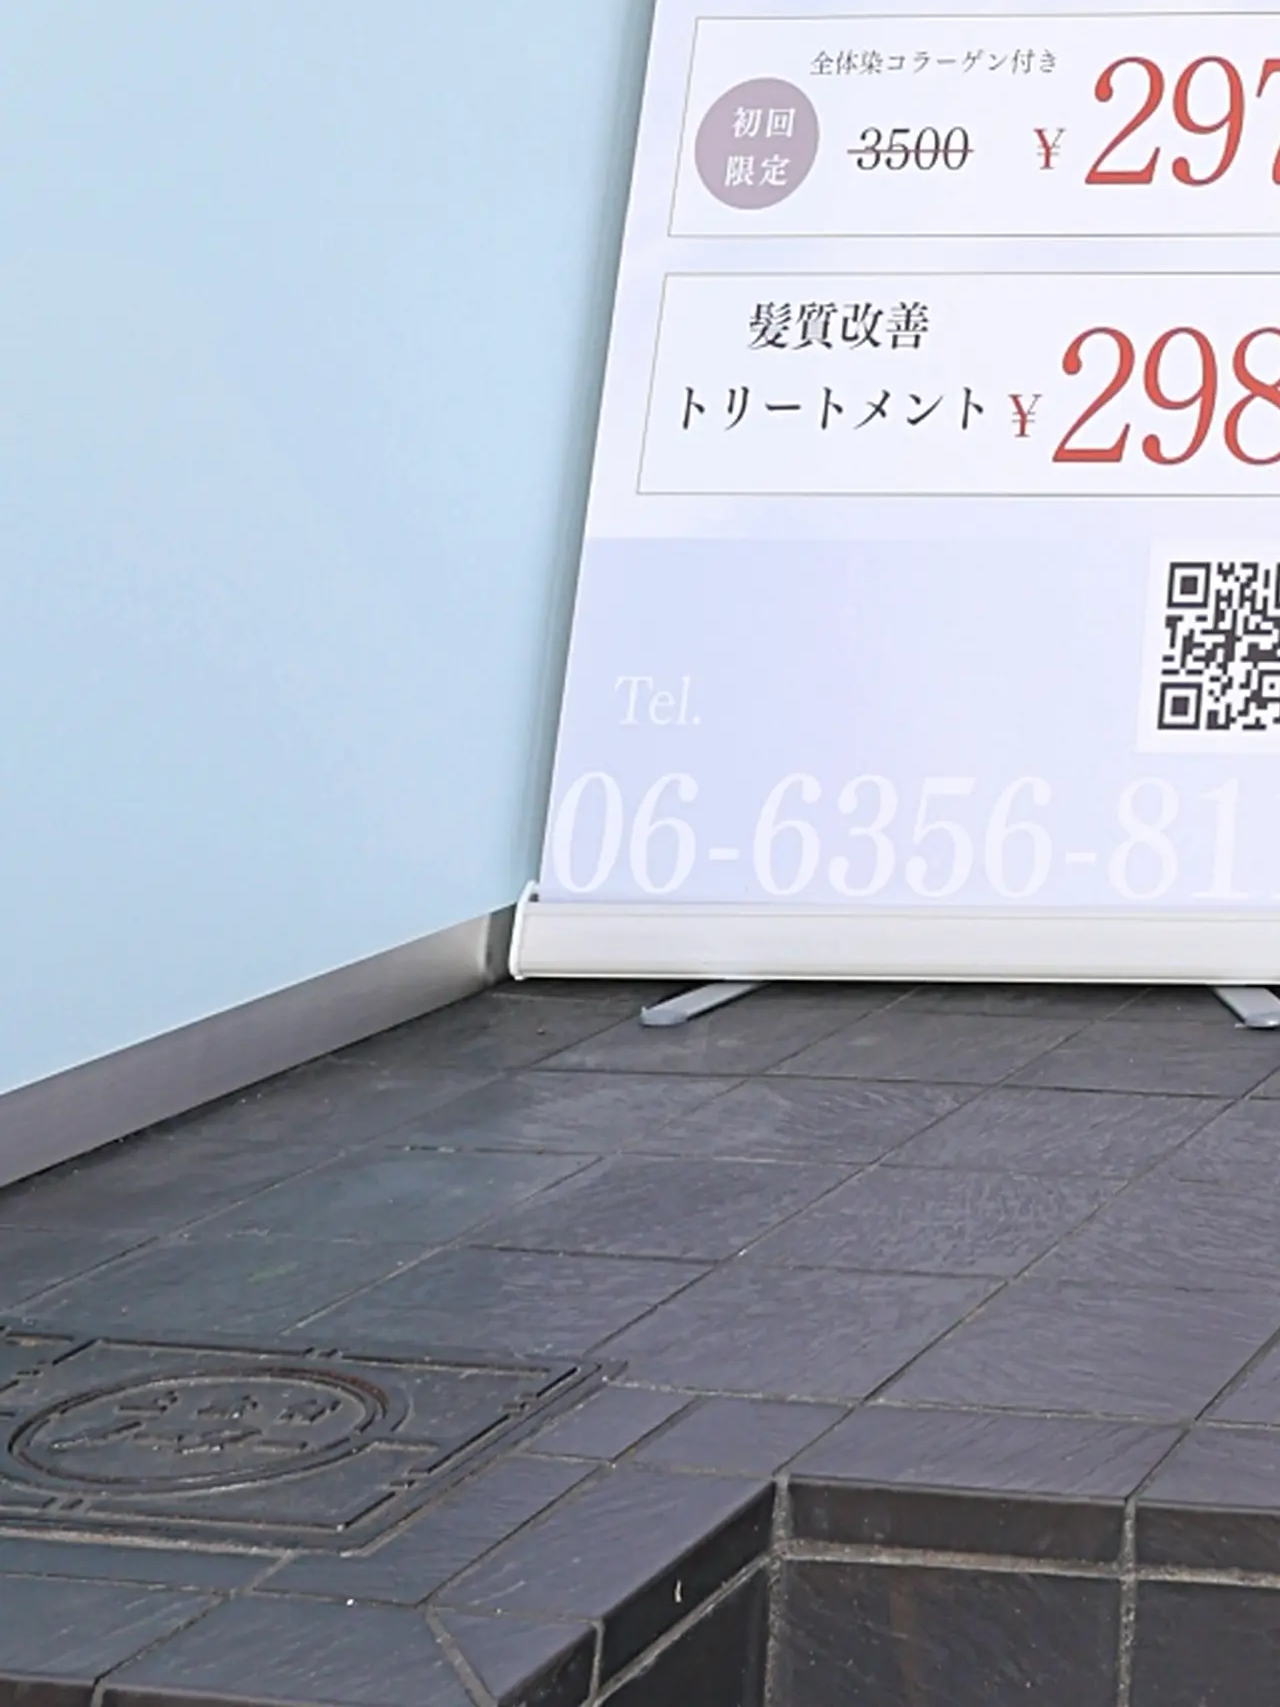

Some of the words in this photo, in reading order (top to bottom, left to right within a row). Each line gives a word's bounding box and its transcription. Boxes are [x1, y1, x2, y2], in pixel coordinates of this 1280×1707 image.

[811, 49, 1058, 76] 全体染コラーゲン付き
[731, 106, 795, 139] 初回
[725, 153, 788, 187] 限定
[856, 127, 971, 173] 3500
[747, 302, 930, 352] 髪質改善
[681, 385, 986, 433] トリートメント
[615, 676, 702, 727] Tel.
